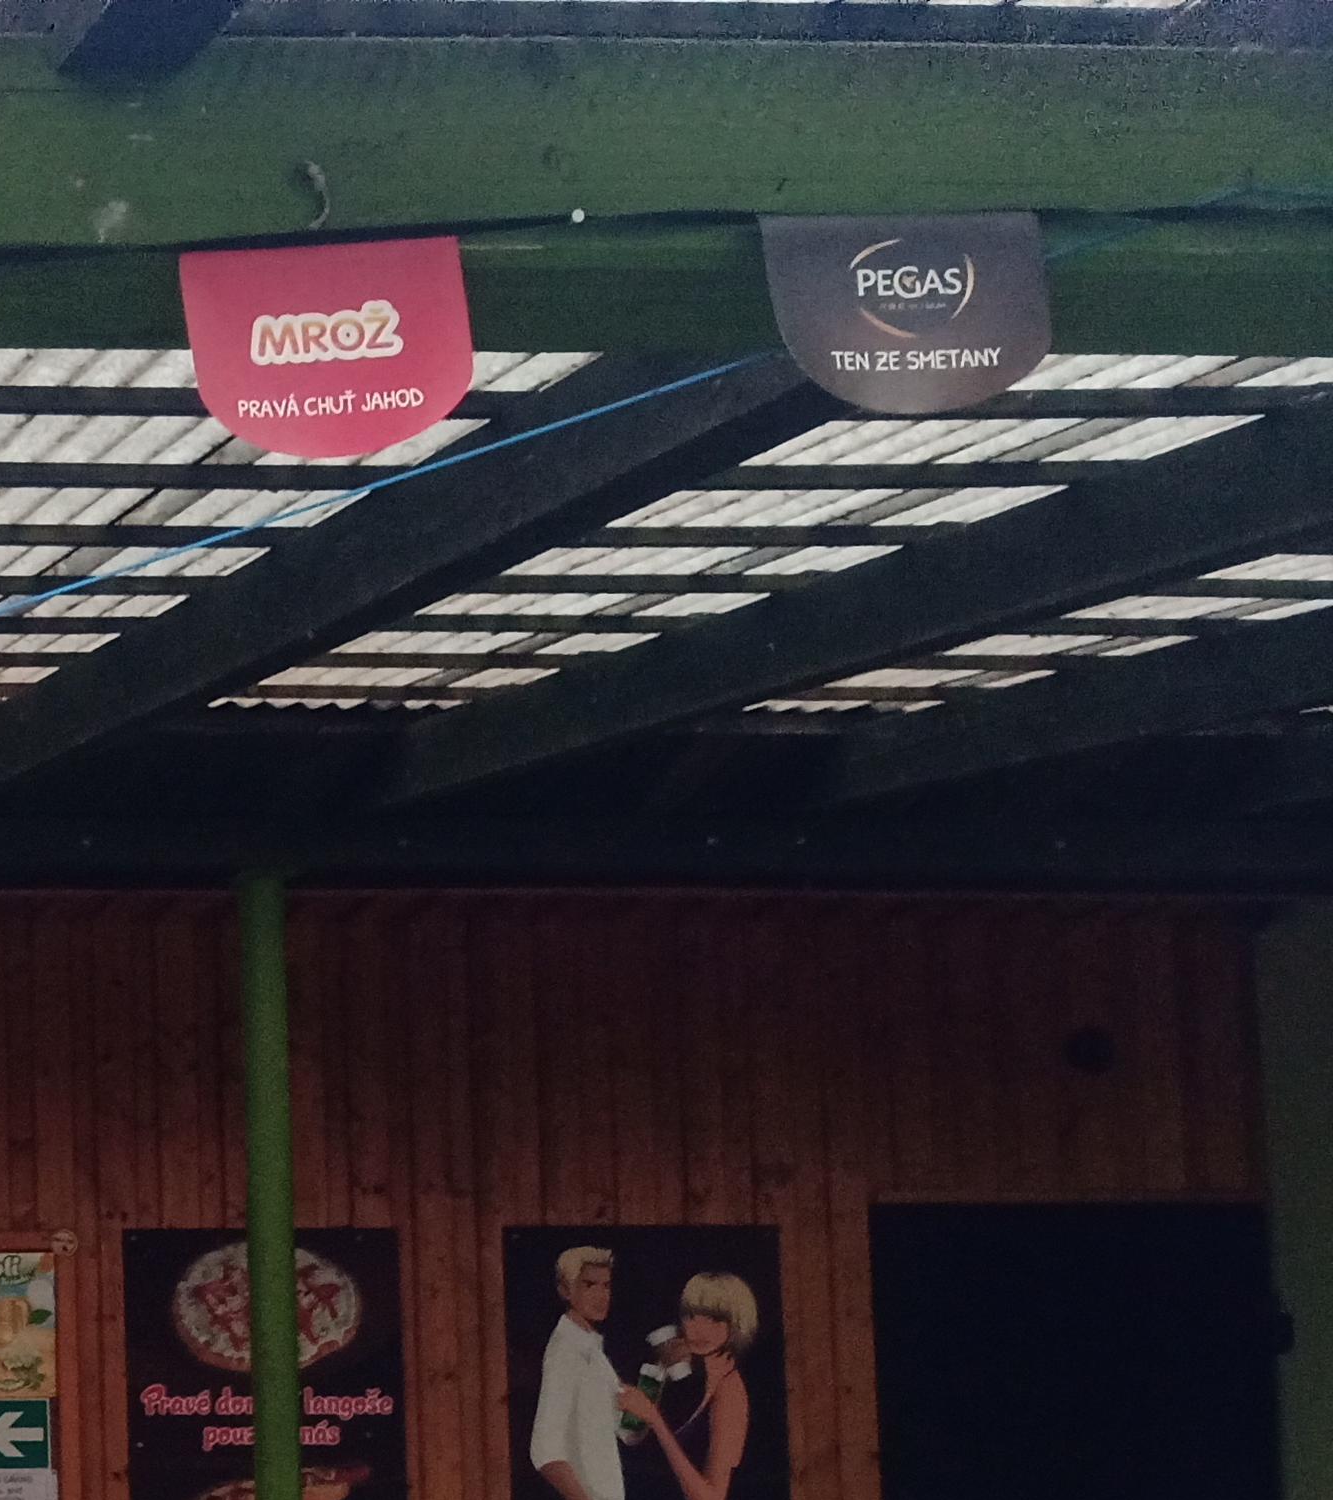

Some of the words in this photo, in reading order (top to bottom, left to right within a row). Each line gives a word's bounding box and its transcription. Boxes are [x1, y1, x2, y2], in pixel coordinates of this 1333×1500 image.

[856, 265, 962, 298] PEGAS
[258, 307, 394, 357] MROŽ
[831, 351, 869, 369] TEN
[875, 351, 900, 370] ZE
[907, 347, 1001, 369] SMETANY
[237, 392, 299, 419] PRAVÁ
[304, 389, 356, 417] CHUŤ
[361, 386, 424, 411] JAHOD
[140, 1383, 210, 1415] Pravé
[302, 1385, 393, 1420] langoše
